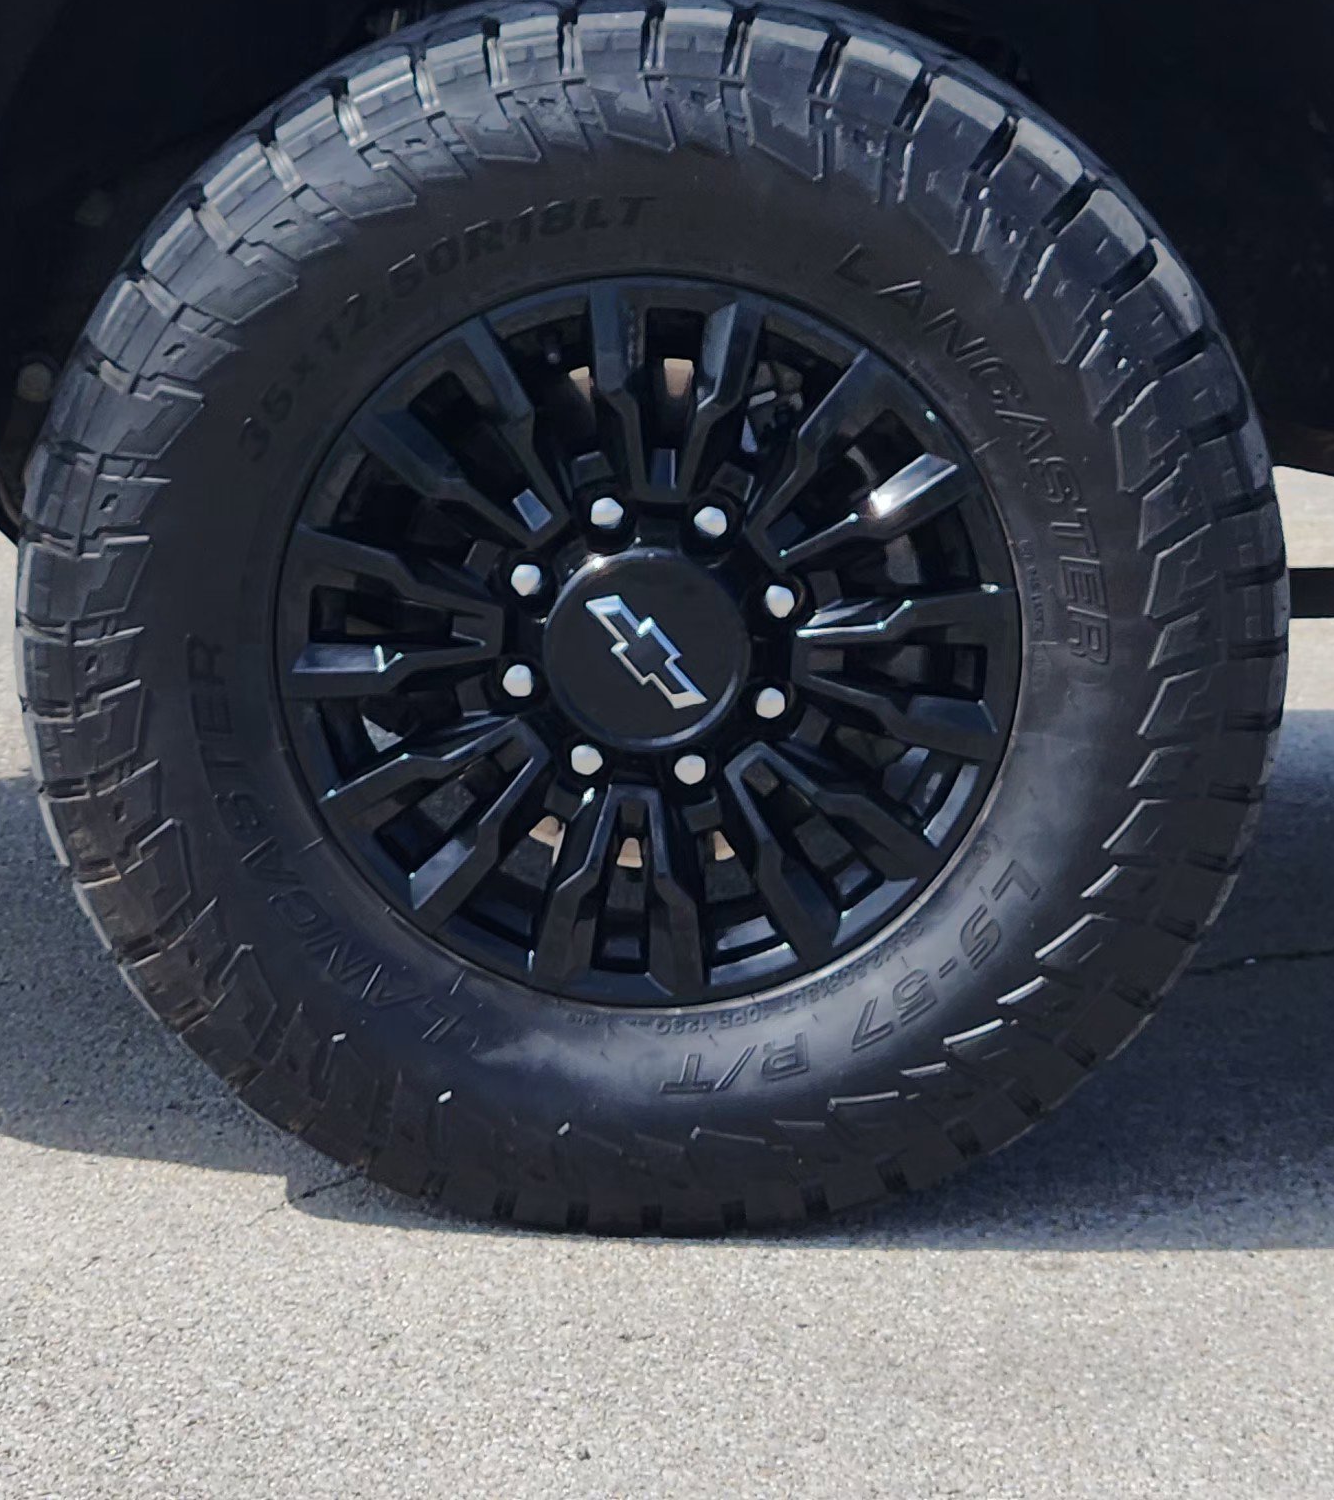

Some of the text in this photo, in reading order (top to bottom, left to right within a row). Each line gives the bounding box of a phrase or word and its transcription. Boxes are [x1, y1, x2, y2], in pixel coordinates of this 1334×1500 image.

[838, 242, 1109, 662] LANCASTER
[189, 638, 463, 1049] LANCASTER
[848, 856, 1041, 1053] LS-57
[661, 1030, 811, 1096] R/T
